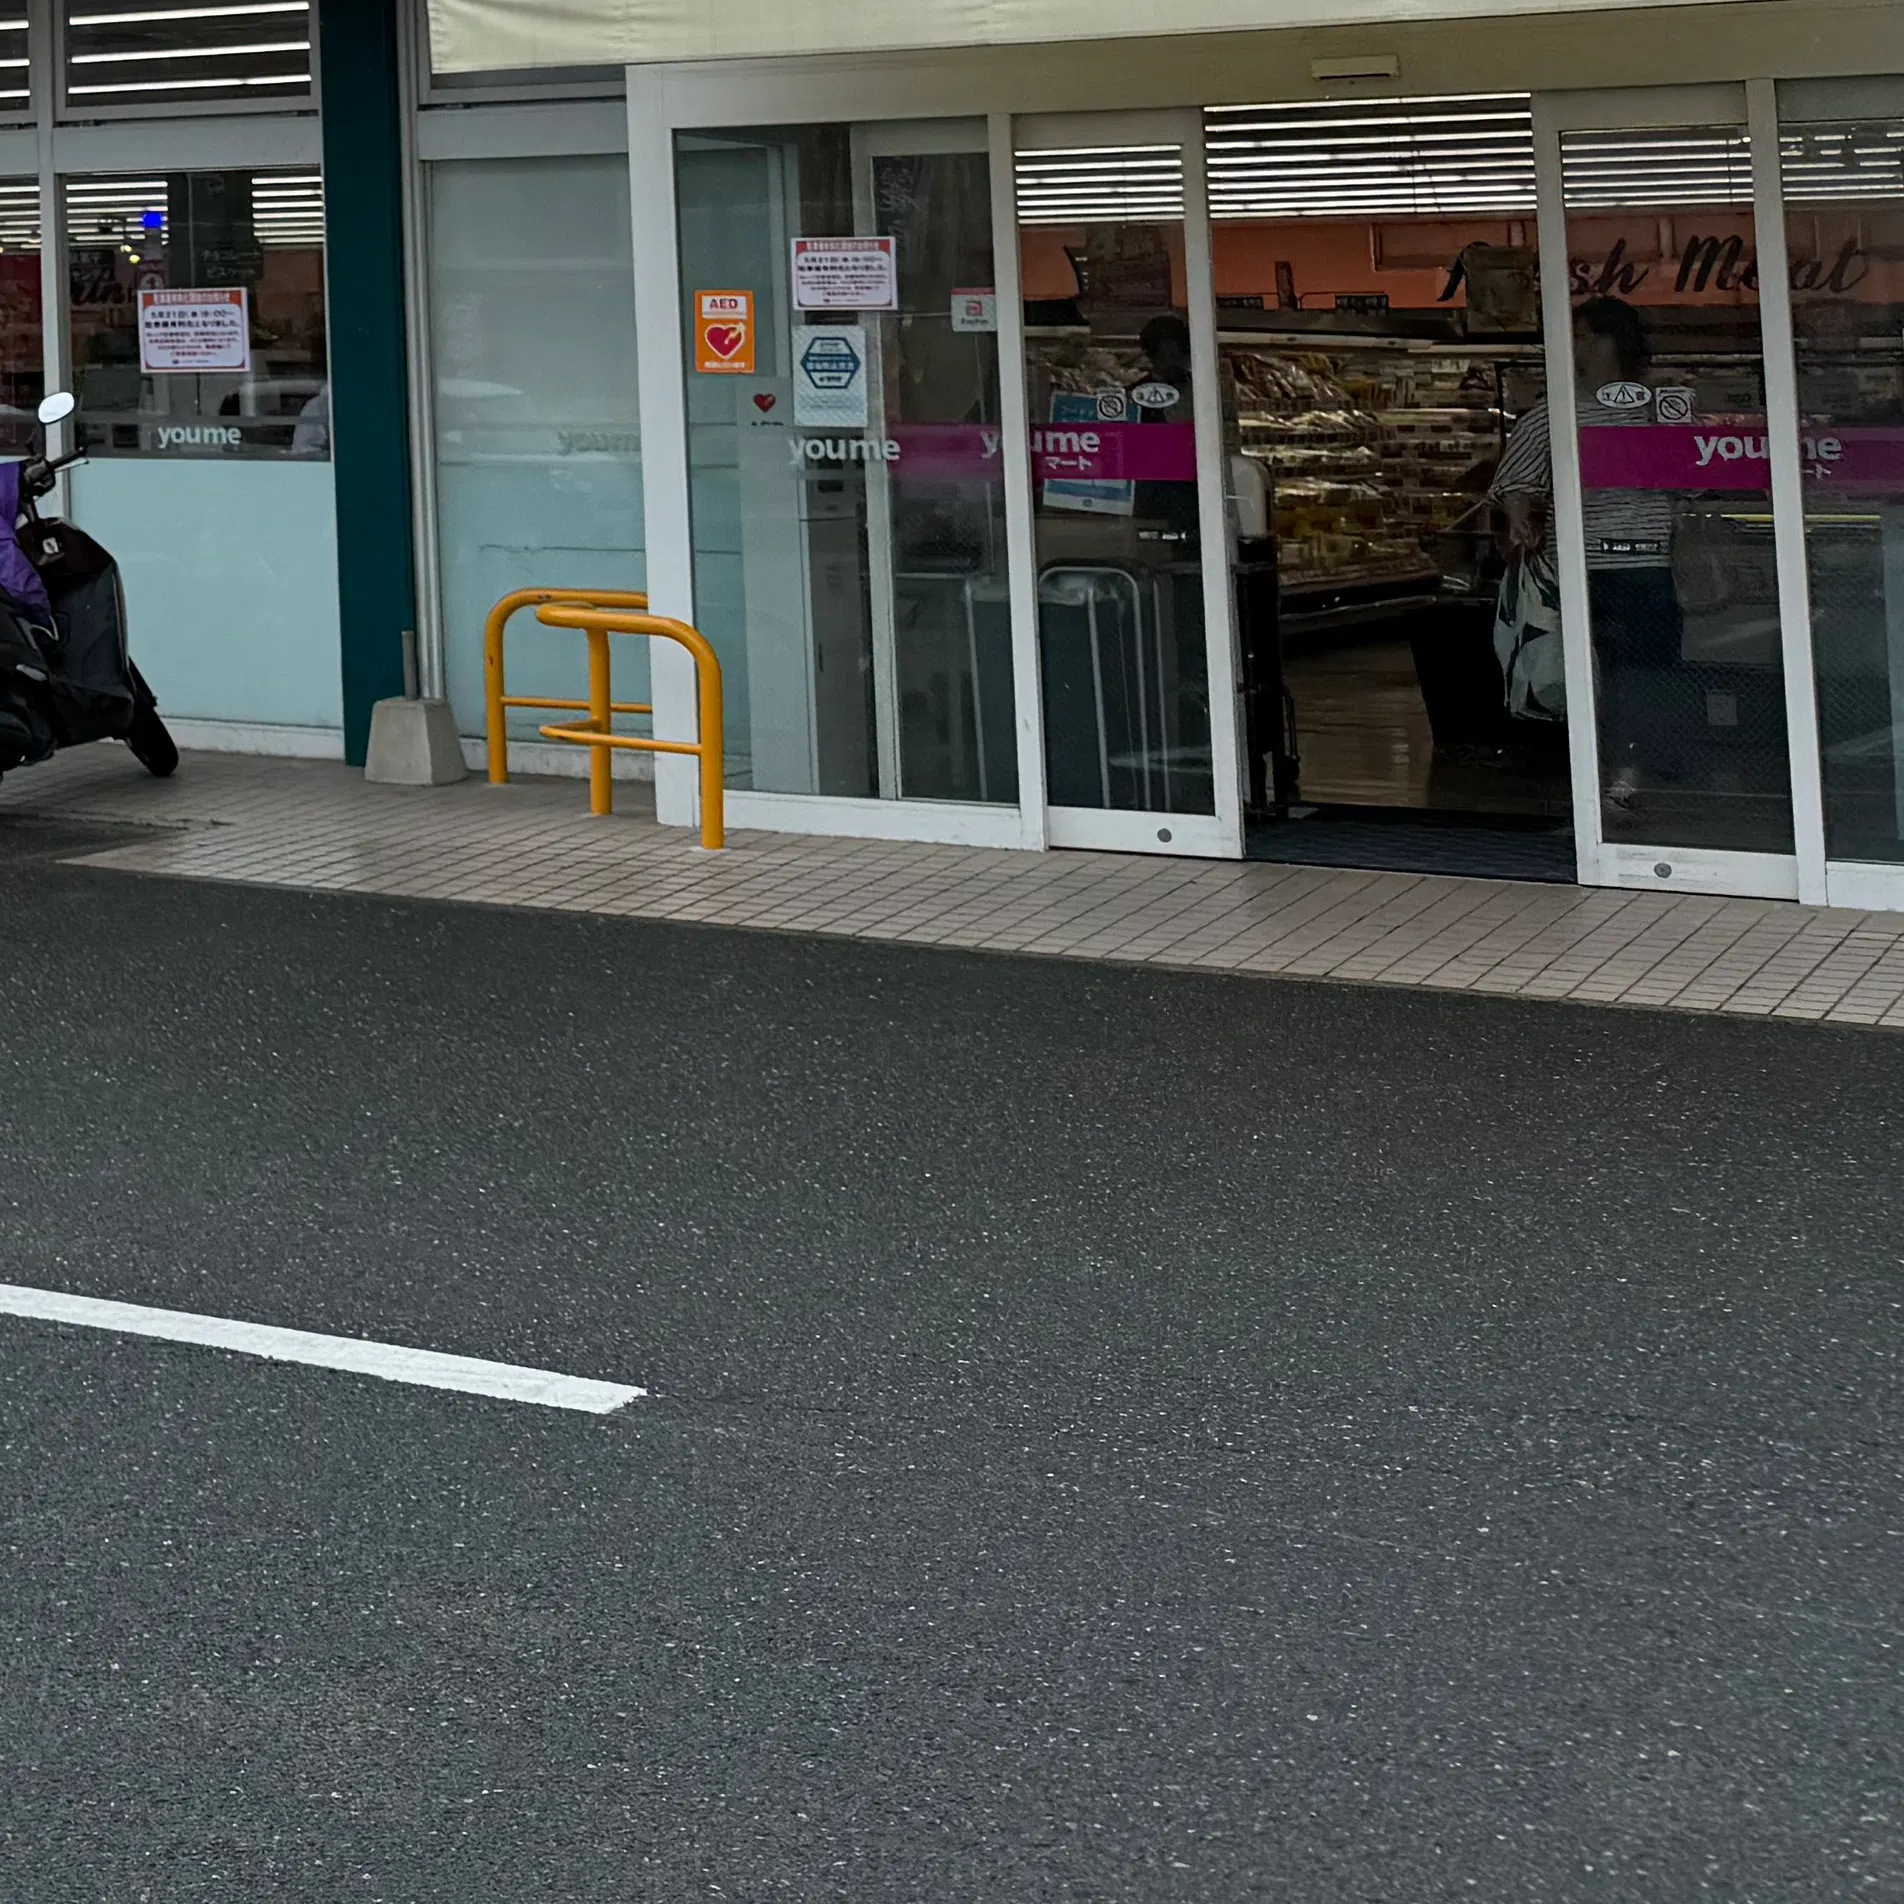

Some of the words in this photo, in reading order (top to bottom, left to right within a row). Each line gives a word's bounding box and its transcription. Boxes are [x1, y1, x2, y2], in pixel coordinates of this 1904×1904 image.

[709, 298, 738, 310] AED
[157, 425, 242, 449] youme
[980, 430, 1101, 459] yume
[788, 436, 902, 465] youme
[1043, 454, 1093, 471] マート
